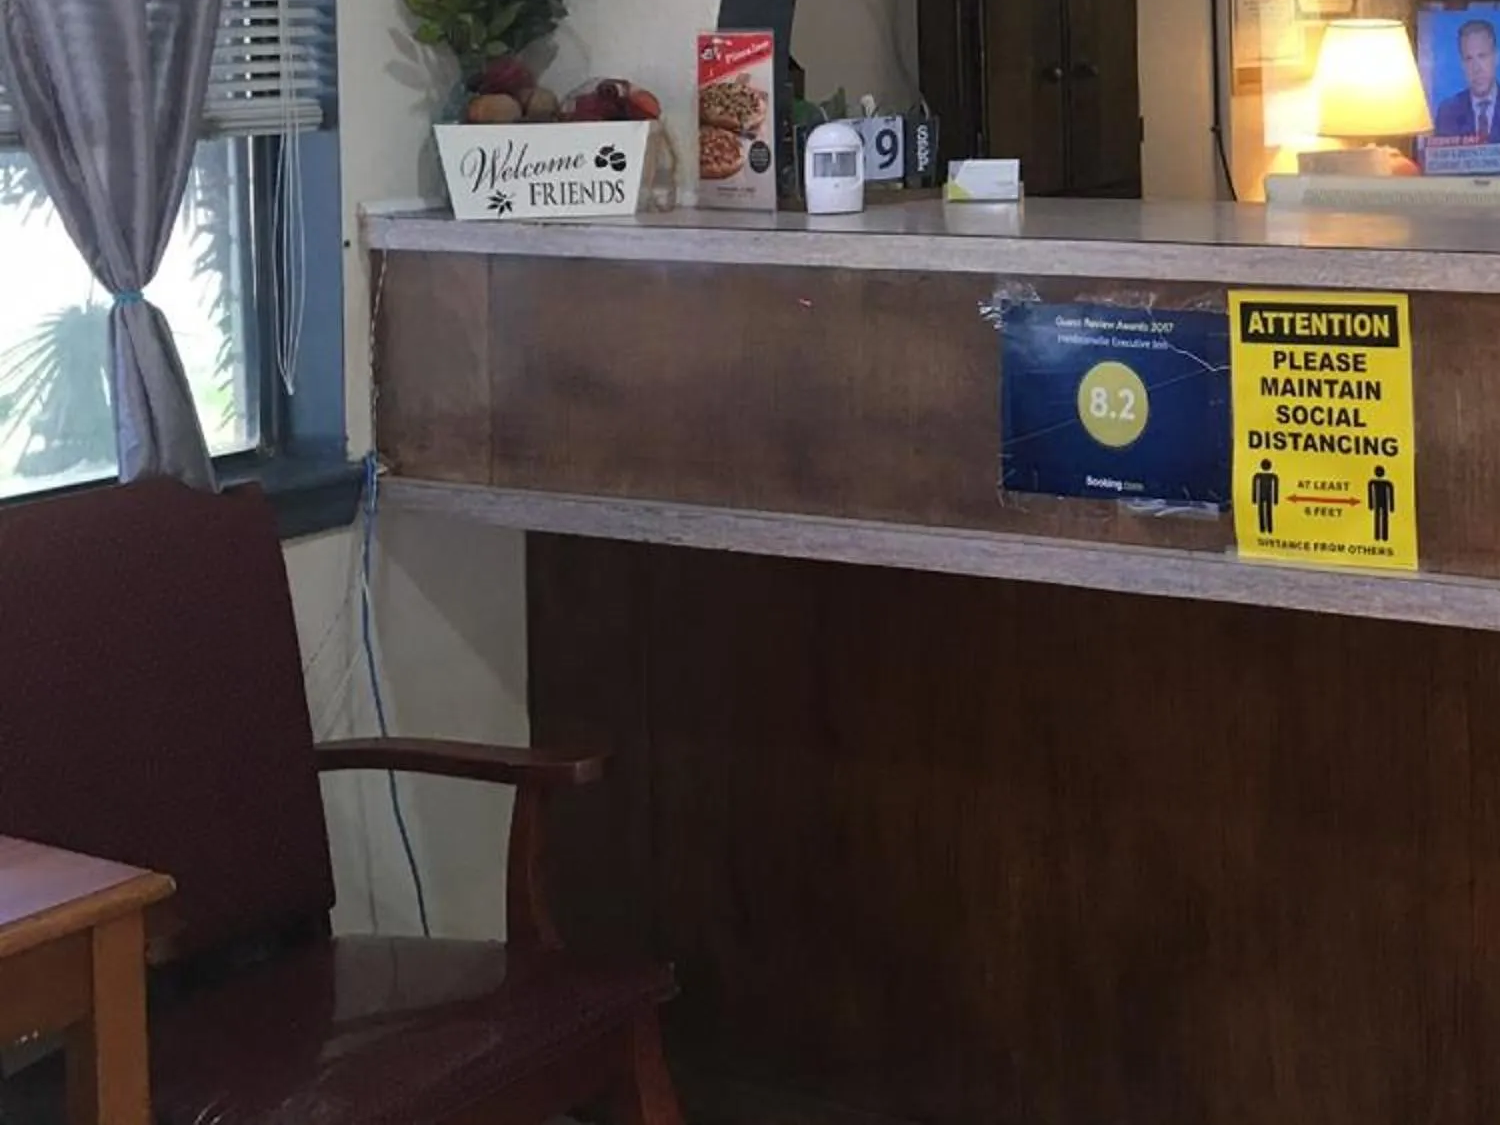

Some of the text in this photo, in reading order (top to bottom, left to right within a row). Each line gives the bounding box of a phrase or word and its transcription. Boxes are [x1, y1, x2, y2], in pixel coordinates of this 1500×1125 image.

[460, 139, 588, 193] Welcome
[529, 179, 625, 206] FRIENDS
[1248, 311, 1390, 338] ATTENTION
[1273, 350, 1367, 372] PLEASE
[1260, 376, 1381, 401] MAINTAIN
[1089, 386, 1135, 421] 8.2
[1276, 404, 1367, 428] SOCIAL
[1248, 430, 1398, 457] DISTANCING
[1298, 480, 1350, 492] AT LEAST
[1313, 507, 1343, 518] FEET
[1257, 538, 1394, 556] DISTANCE FROM OTHERS
